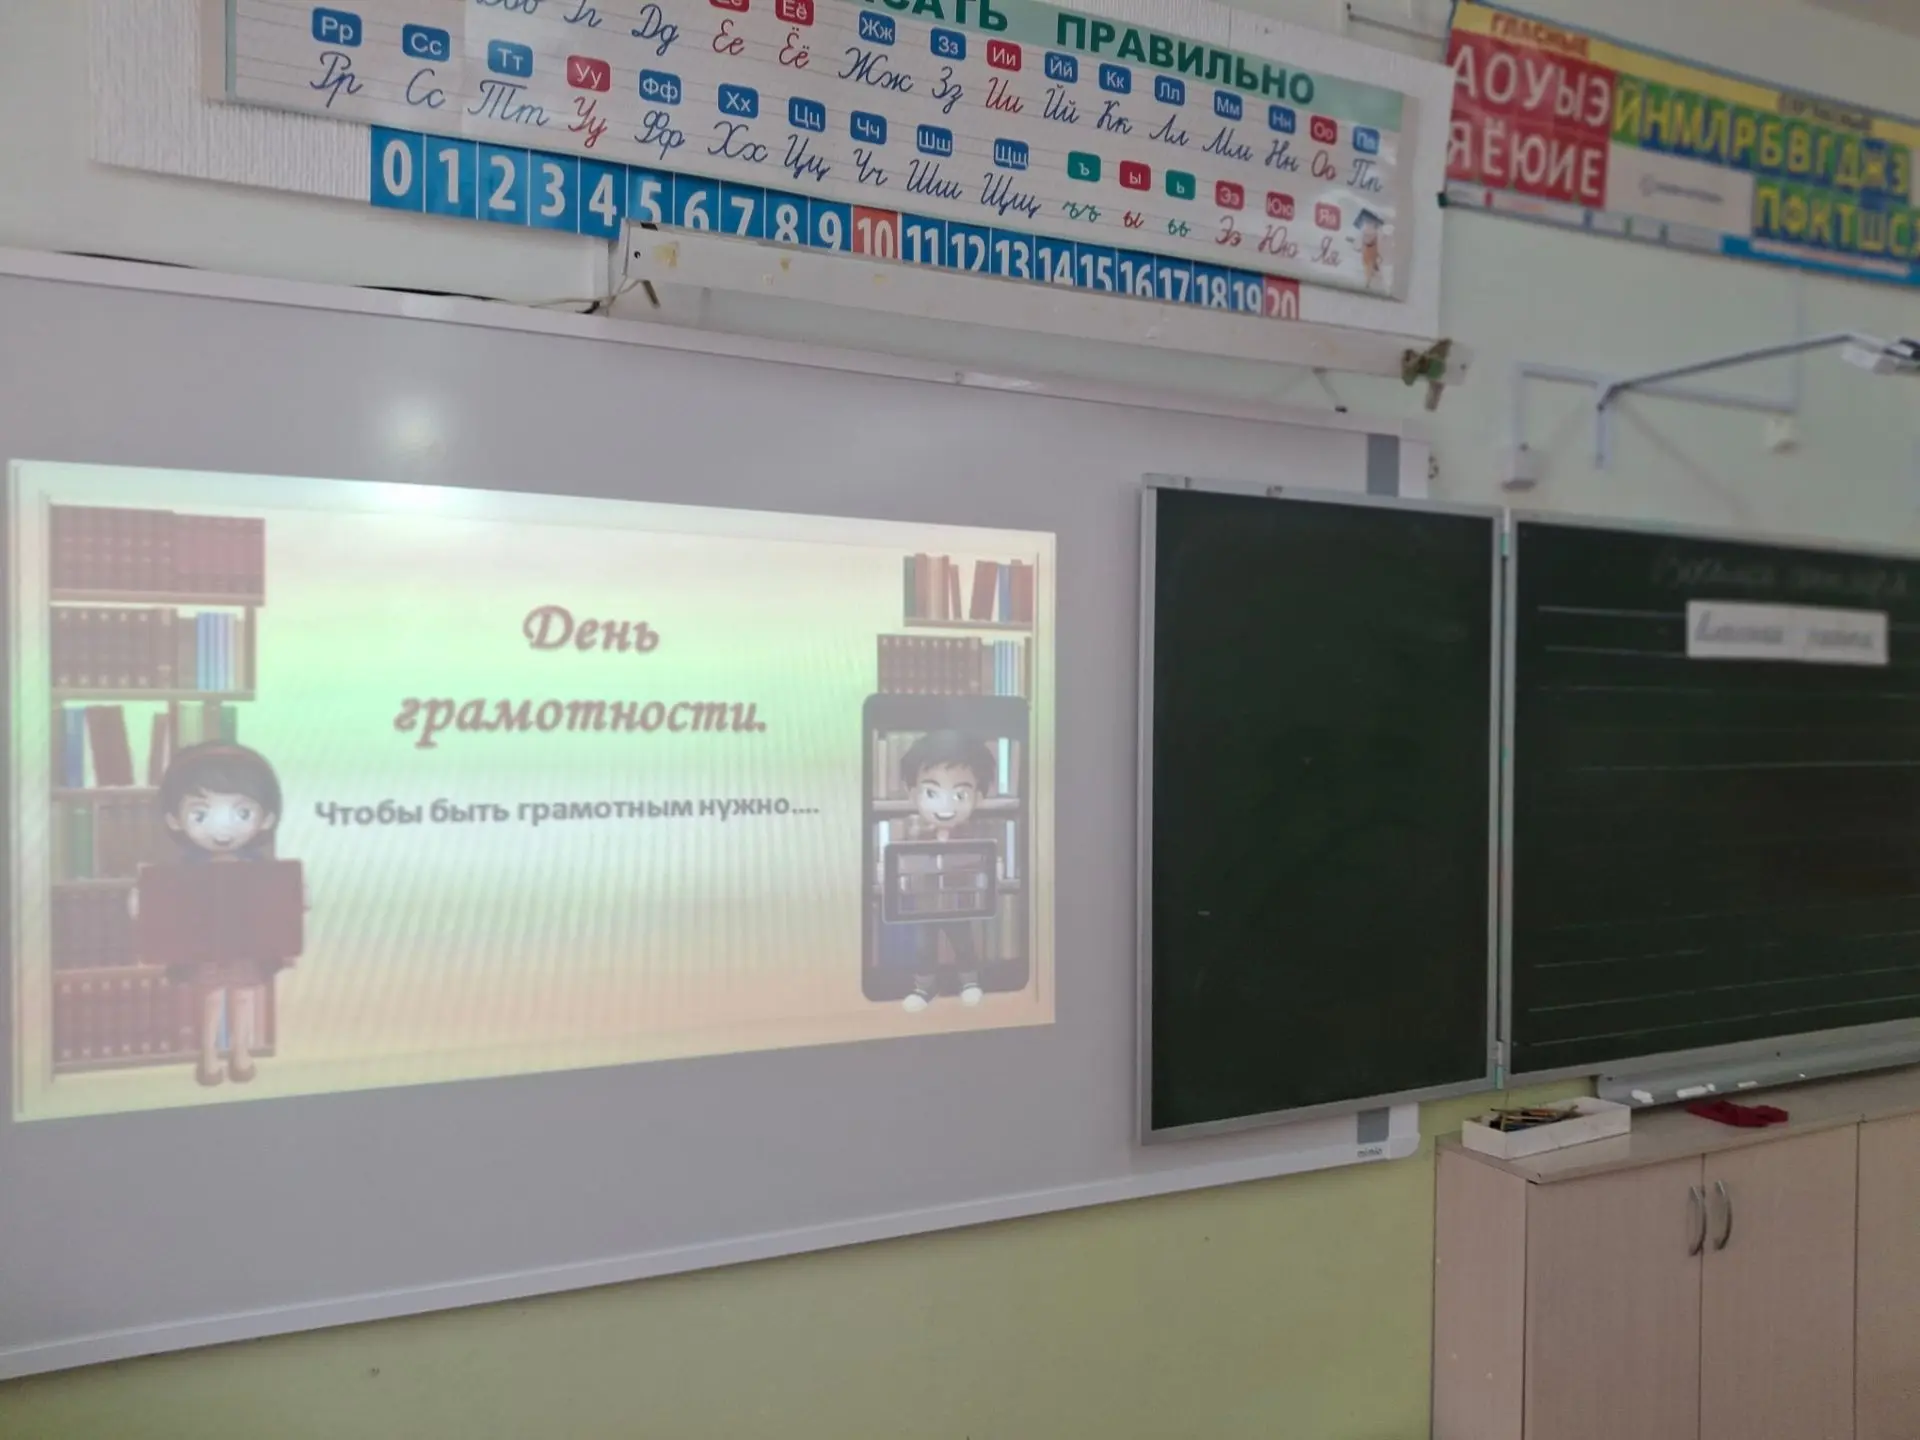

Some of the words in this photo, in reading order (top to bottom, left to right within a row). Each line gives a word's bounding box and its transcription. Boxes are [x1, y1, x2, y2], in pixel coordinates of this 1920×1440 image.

[861, 16, 893, 40] Жж
[938, 35, 959, 55] Зз
[992, 47, 1016, 67] Ии
[1050, 56, 1073, 78] Йй
[1106, 71, 1125, 89] Кк
[1160, 81, 1180, 100] Лл
[1216, 97, 1241, 117] Мм
[1272, 111, 1292, 129] Нн
[1314, 121, 1334, 141] Оо
[1355, 131, 1376, 149] Пп
[1057, 13, 1314, 105] ПРАВИЛЬНО
[321, 17, 353, 45] Рр
[410, 32, 442, 56] Сс
[498, 48, 524, 71] Тт
[575, 63, 602, 89] Уу
[643, 77, 678, 103] Фф
[726, 91, 751, 112] Хх
[794, 104, 821, 130] Цц
[857, 117, 880, 139] Чч
[918, 131, 951, 151] Шш
[994, 143, 1029, 168] Щщ
[1220, 186, 1239, 205] Ээ
[1266, 196, 1293, 216] Юю
[1319, 209, 1337, 224] Яя
[383, 139, 412, 197] 0
[438, 149, 460, 203] 1
[489, 155, 516, 212] 2
[540, 163, 566, 218] 3
[588, 174, 617, 227] 4
[640, 181, 662, 223] 5
[684, 191, 710, 231] 6
[731, 197, 754, 237] 7
[774, 204, 799, 245] 8
[819, 211, 842, 251] 9
[857, 217, 894, 259] 10
[906, 225, 939, 267] 11
[952, 232, 985, 272] 12
[996, 240, 1030, 280] 13
[1039, 247, 1073, 287] 14
[1080, 254, 1112, 291] 15
[1120, 260, 1152, 297] 16
[1159, 267, 1190, 302] 17
[1196, 274, 1228, 308] 18
[1233, 280, 1262, 315] 19
[522, 604, 660, 654] День
[393, 695, 768, 750] грамотности.
[315, 799, 423, 827] Чтобы
[430, 796, 510, 824] быть
[517, 797, 693, 827] грамотным
[699, 795, 820, 822] нужно....
